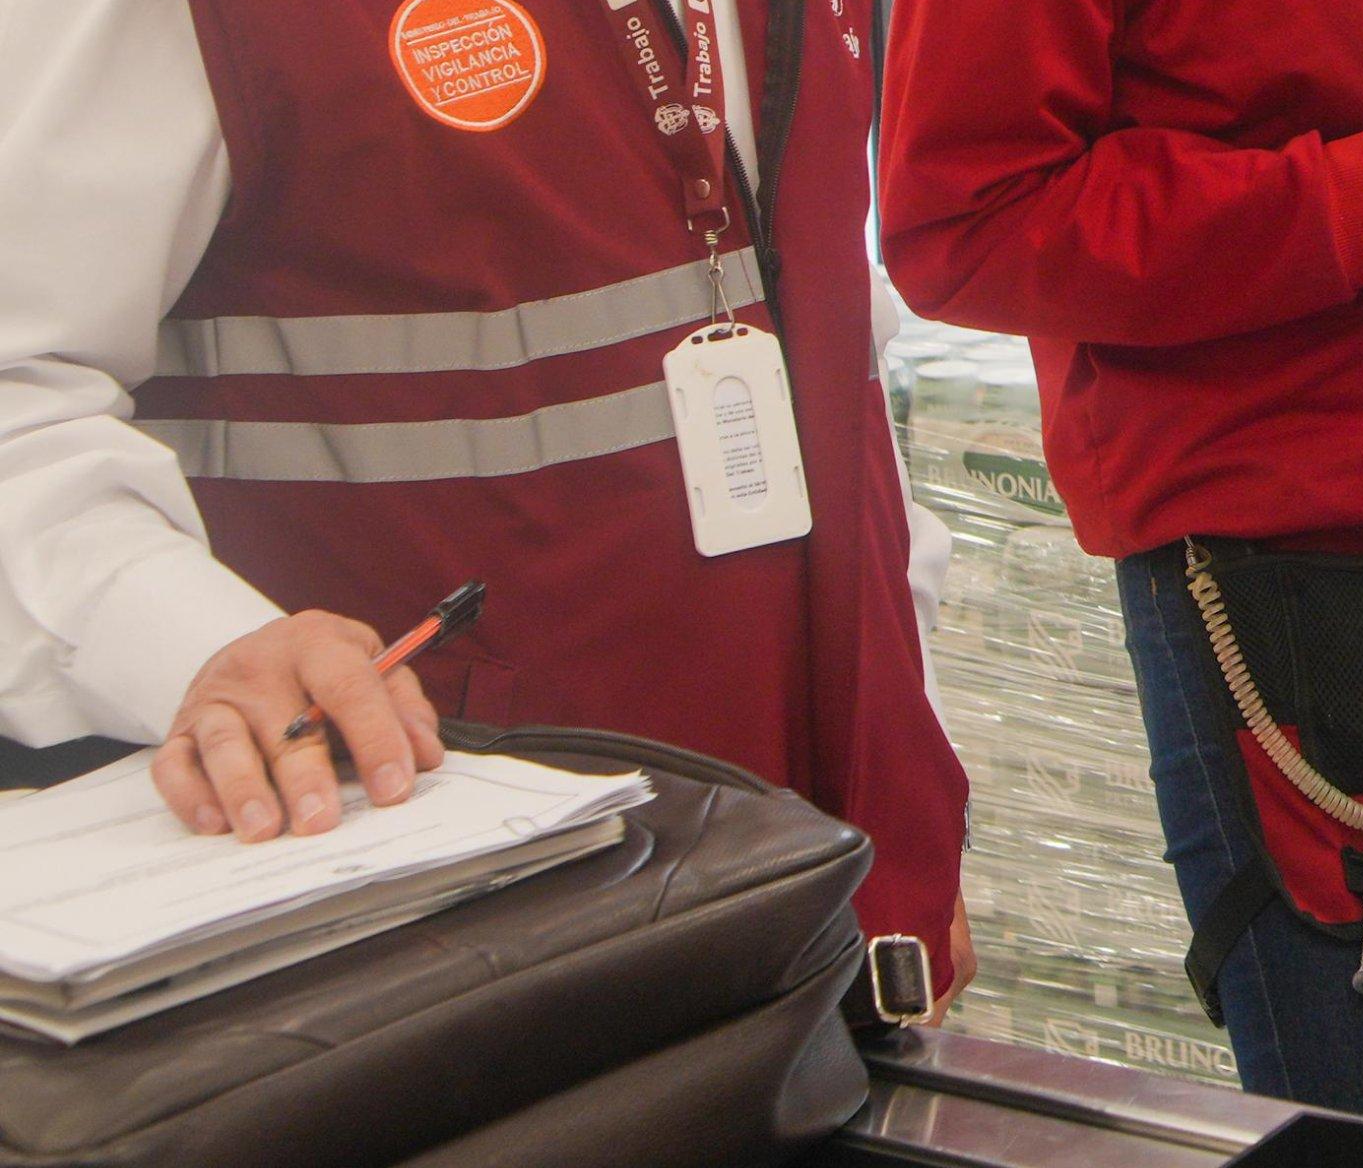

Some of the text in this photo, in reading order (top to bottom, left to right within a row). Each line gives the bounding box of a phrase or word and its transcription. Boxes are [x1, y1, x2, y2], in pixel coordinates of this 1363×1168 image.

[412, 22, 513, 65] INSPECCIÓN
[421, 42, 522, 83] VIGILANCIA
[626, 16, 670, 100] Trabajo
[693, 21, 713, 98] Trabajo
